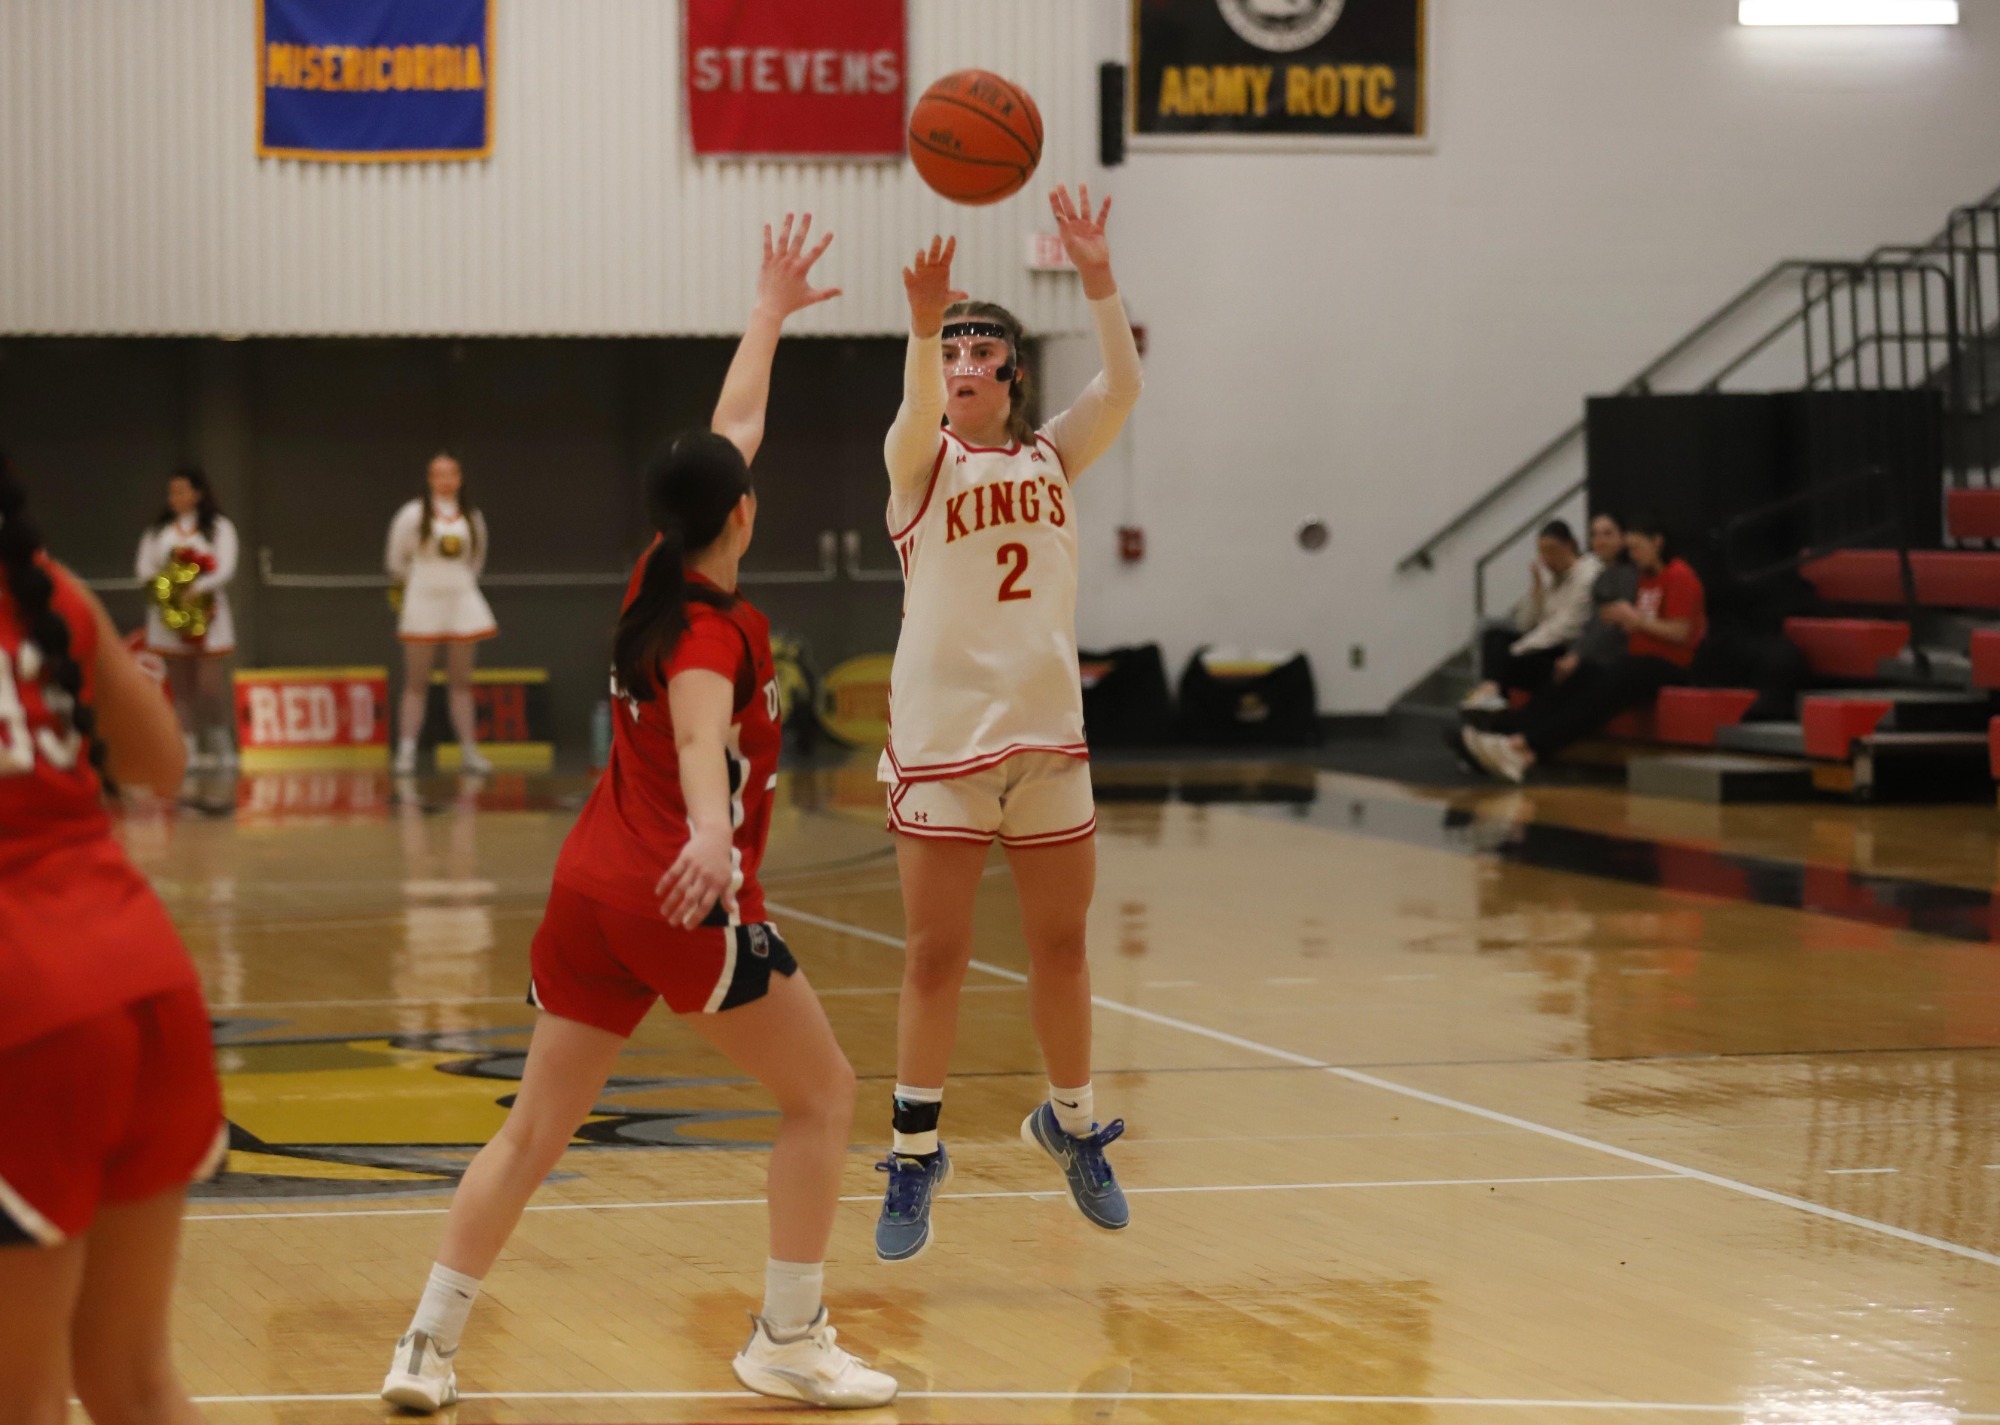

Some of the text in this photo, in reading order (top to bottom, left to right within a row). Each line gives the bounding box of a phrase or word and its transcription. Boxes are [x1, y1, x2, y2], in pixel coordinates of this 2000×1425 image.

[266, 41, 484, 91] MISERICORDIA
[694, 46, 900, 94] STEVENS
[1158, 64, 1397, 119] ARMY ROTC
[945, 475, 1066, 544] KING'S
[995, 542, 1033, 603] 2
[248, 685, 338, 743] RED
